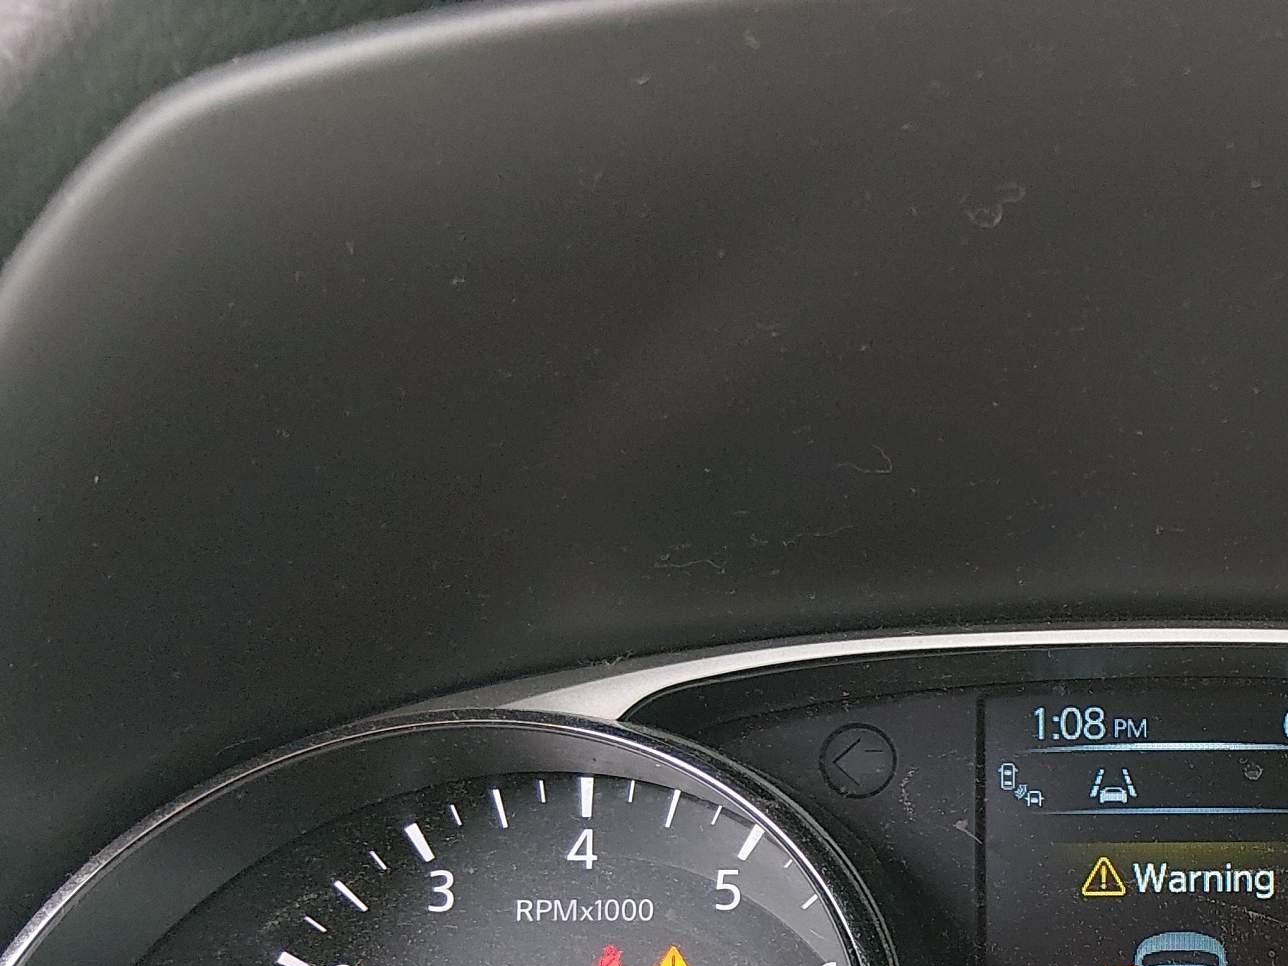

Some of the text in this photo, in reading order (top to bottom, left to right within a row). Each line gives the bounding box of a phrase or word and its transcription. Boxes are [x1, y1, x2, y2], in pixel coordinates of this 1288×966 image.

[1033, 706, 1149, 741] 1:08 PM
[566, 828, 598, 870] 4
[427, 869, 455, 913] 3
[715, 869, 742, 911] 5
[1132, 862, 1276, 900] Warning
[516, 898, 655, 922] RPMx1000
